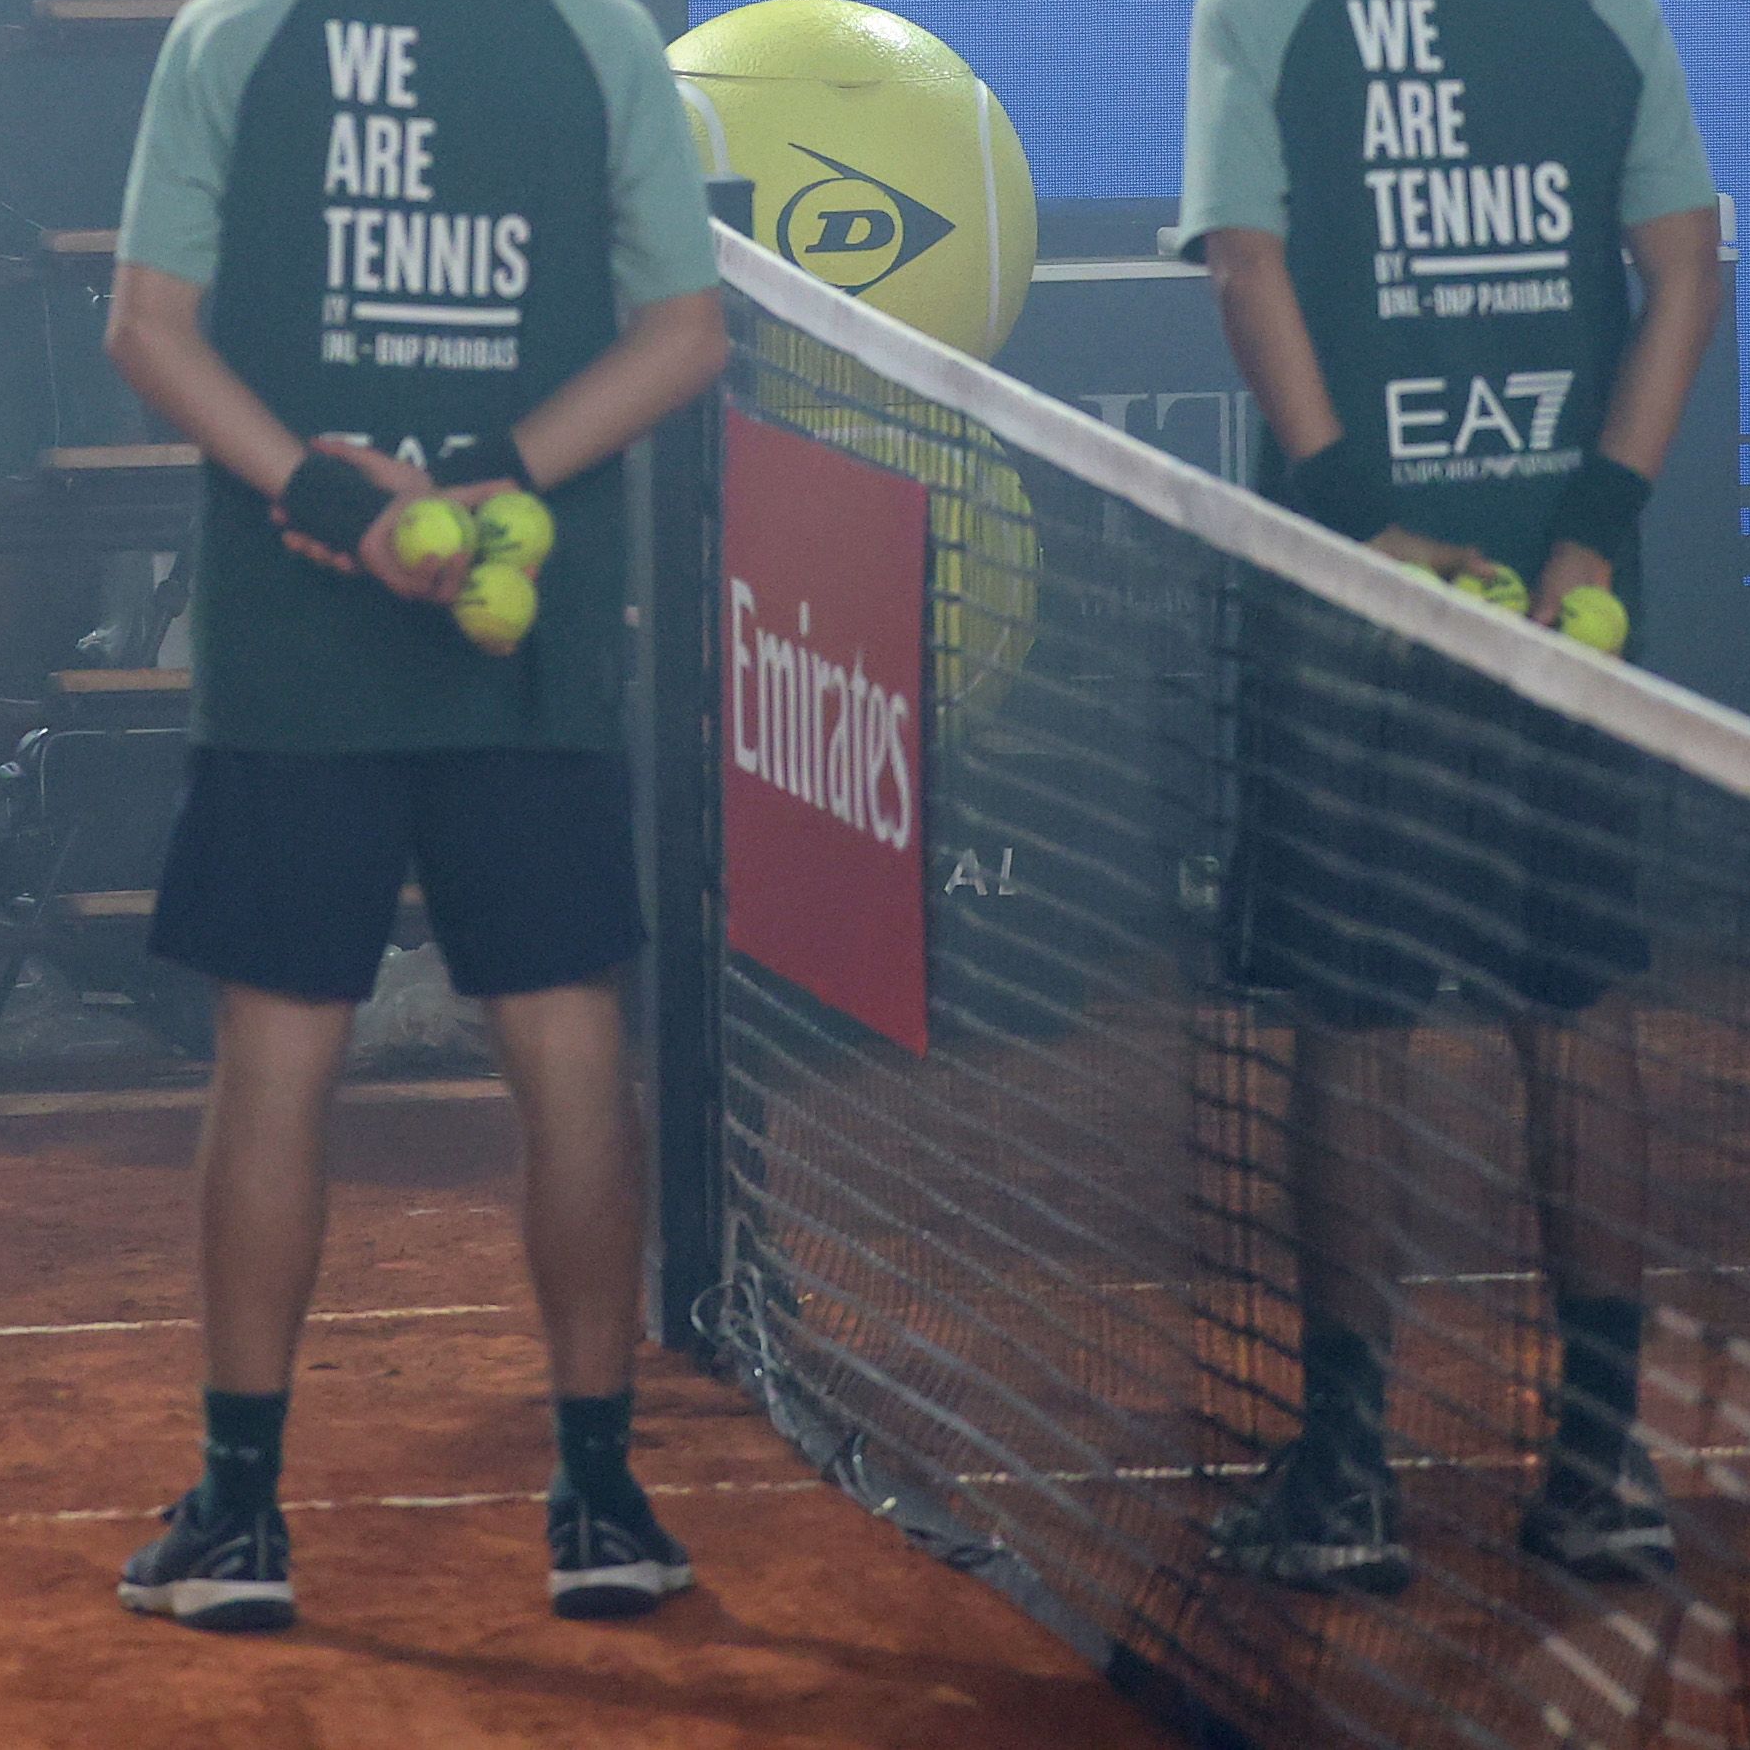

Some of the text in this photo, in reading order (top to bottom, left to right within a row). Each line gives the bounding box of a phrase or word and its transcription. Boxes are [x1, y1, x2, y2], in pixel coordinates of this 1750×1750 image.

[324, 18, 420, 108] WE
[323, 113, 437, 202] ARE
[1363, 78, 1468, 162] ARE
[1365, 161, 1573, 250] TENNIS
[323, 207, 531, 300] TENNIS
[1385, 369, 1575, 459] EA7
[729, 578, 914, 852] Emirates
